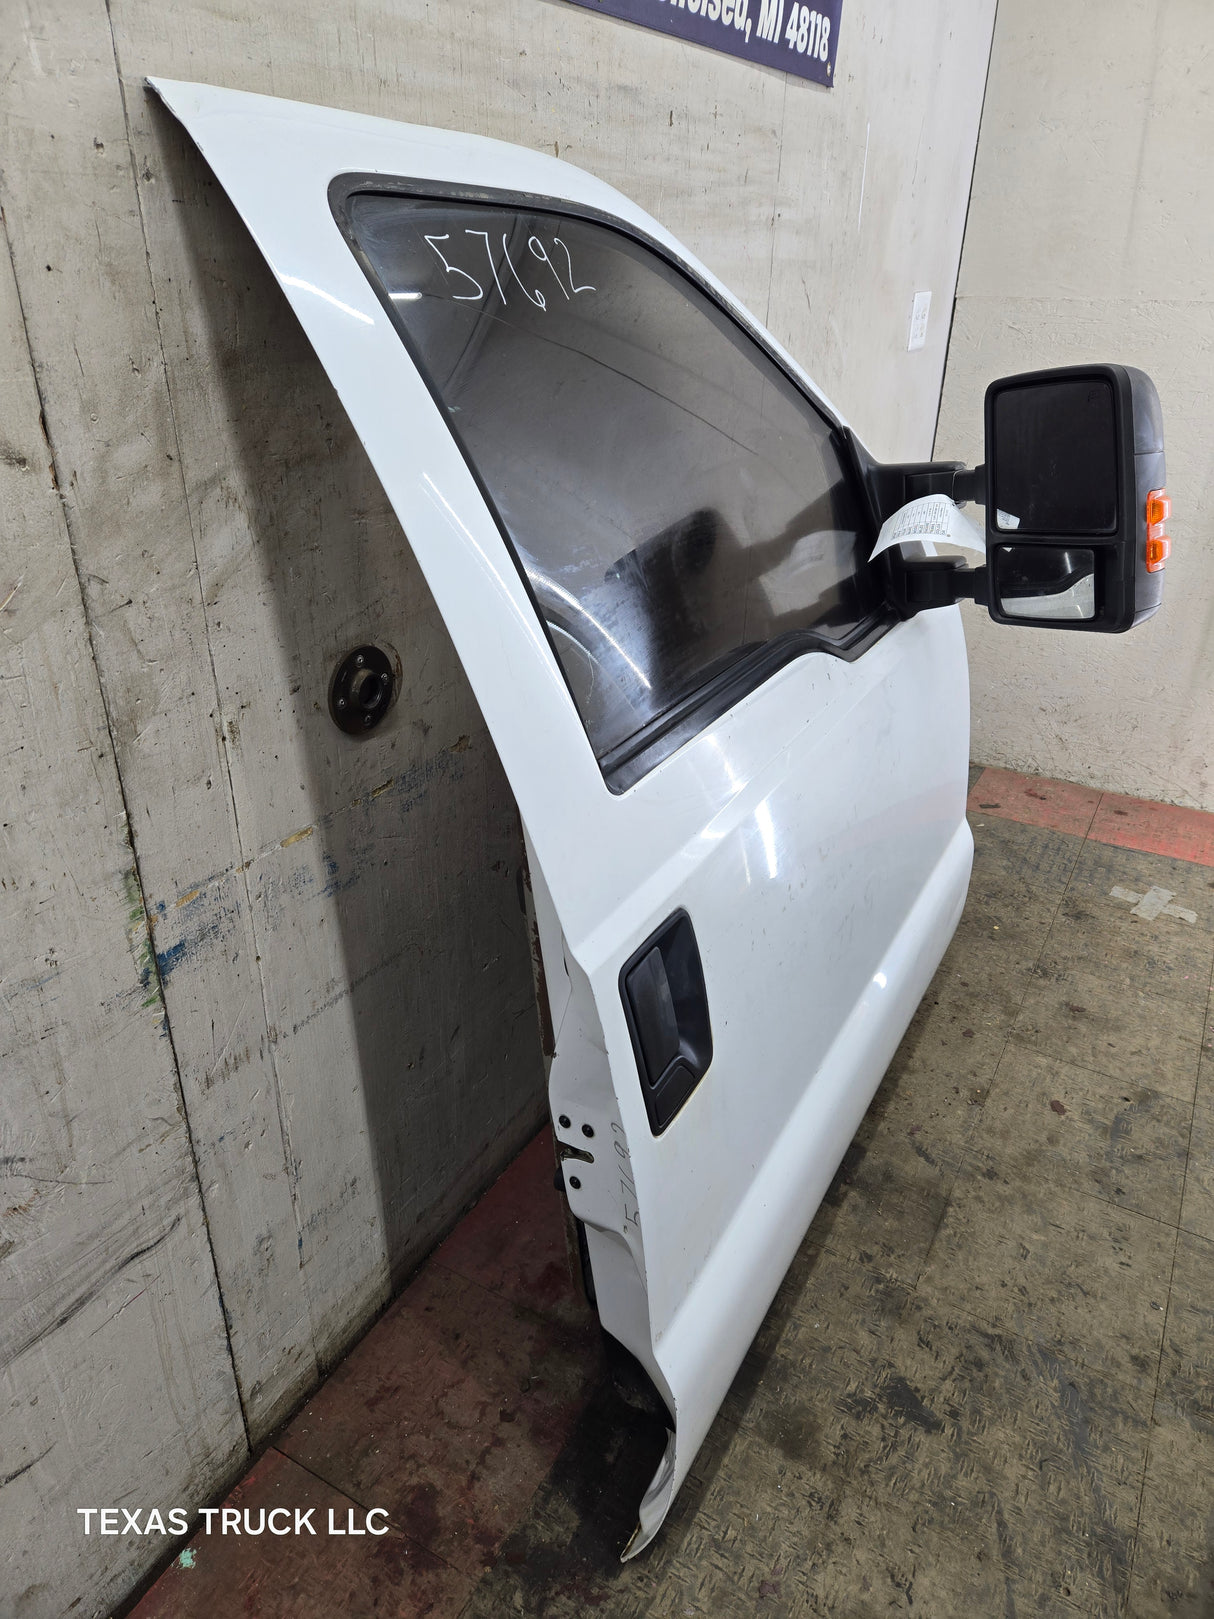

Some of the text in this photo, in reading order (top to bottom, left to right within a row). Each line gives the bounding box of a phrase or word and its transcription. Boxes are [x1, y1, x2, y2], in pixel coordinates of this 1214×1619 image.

[756, 0, 784, 43] MI
[784, 2, 830, 62] 48118
[424, 229, 597, 312] 57692
